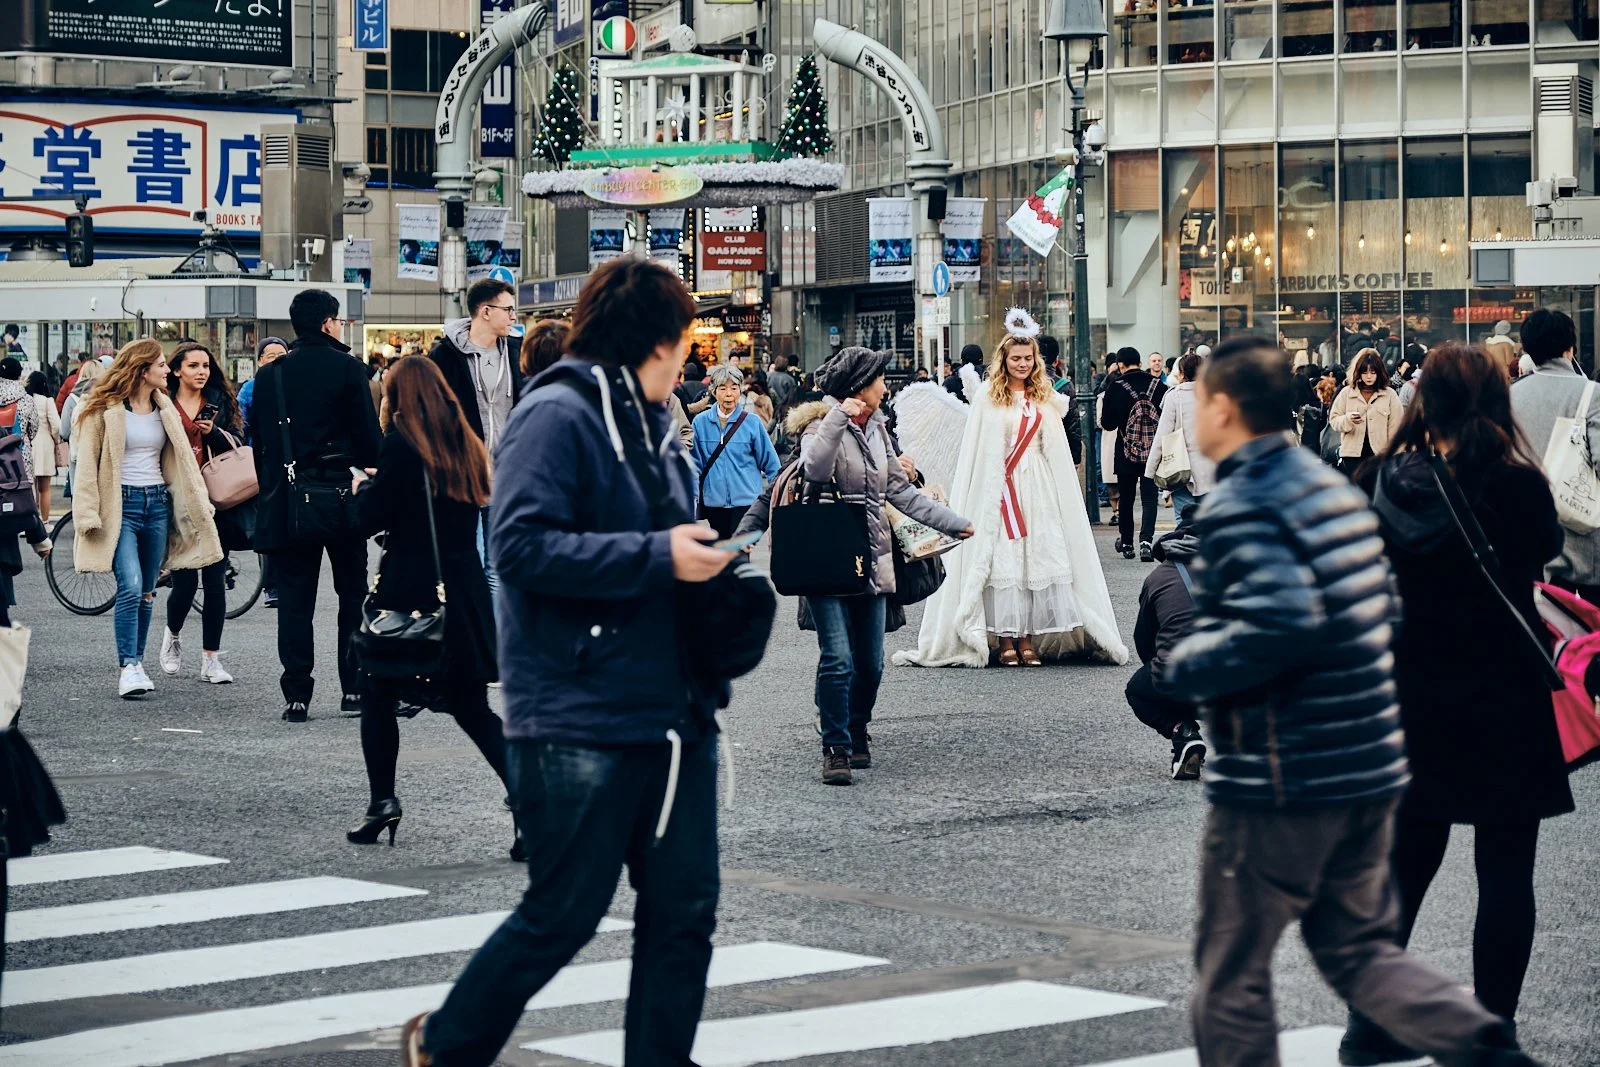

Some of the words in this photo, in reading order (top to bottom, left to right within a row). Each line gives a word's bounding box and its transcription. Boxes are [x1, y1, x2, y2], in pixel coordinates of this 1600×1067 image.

[0, 125, 260, 206] 堂書店
[216, 214, 246, 225] BOOKS
[707, 247, 729, 255] GAS
[731, 247, 763, 255] PANIC
[554, 279, 580, 301] AOYAMA
[1270, 273, 1350, 292] SARBUCKS
[1353, 272, 1433, 289] COFFEE
